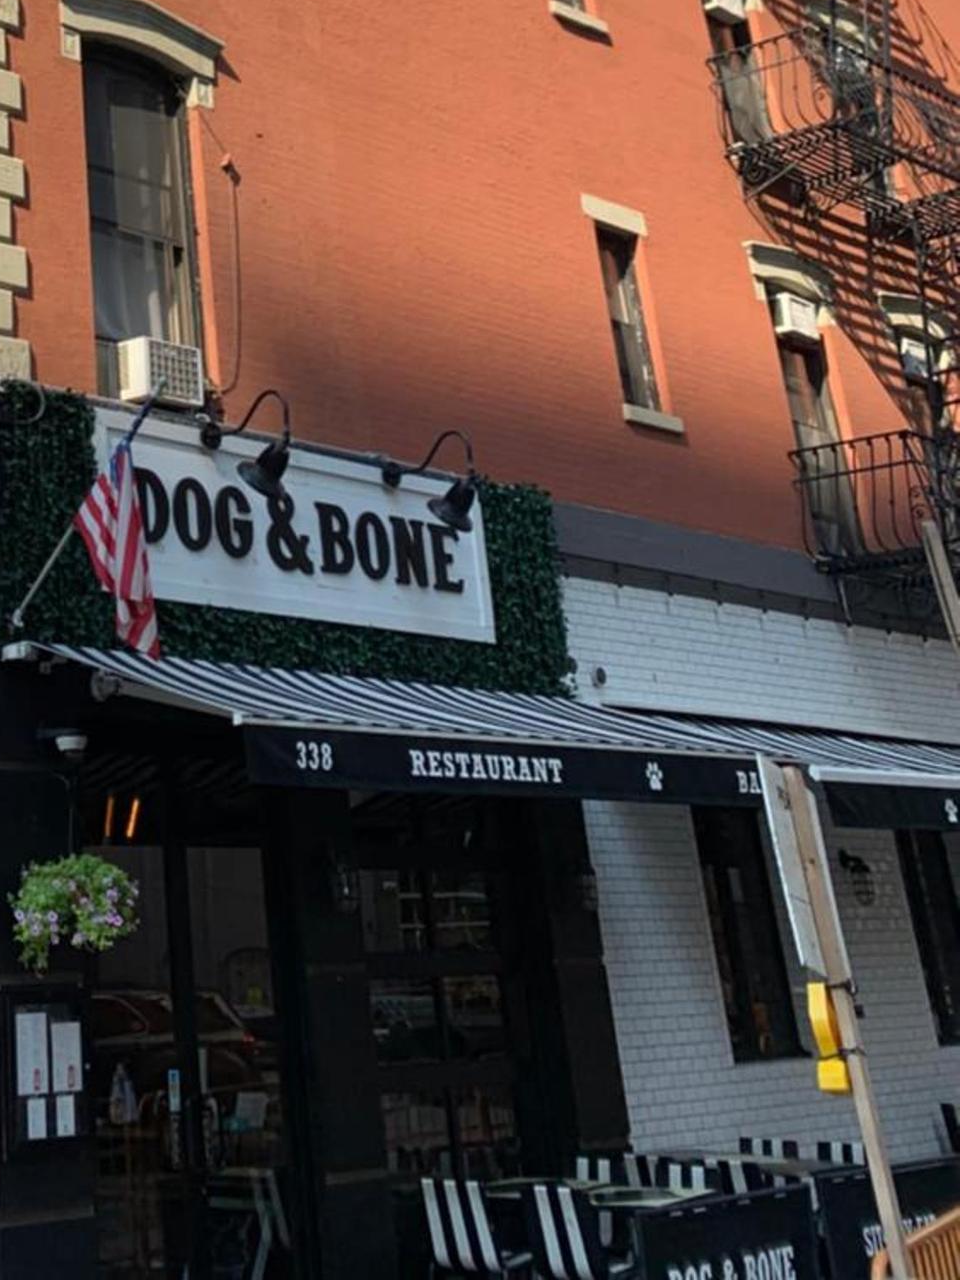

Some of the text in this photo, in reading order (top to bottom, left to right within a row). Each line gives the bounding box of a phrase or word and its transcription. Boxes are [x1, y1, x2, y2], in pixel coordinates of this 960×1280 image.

[133, 467, 253, 559] DOG
[314, 501, 465, 594] BONE
[296, 741, 333, 771] 338
[408, 748, 563, 783] RESTAURANT
[735, 770, 761, 794] BA
